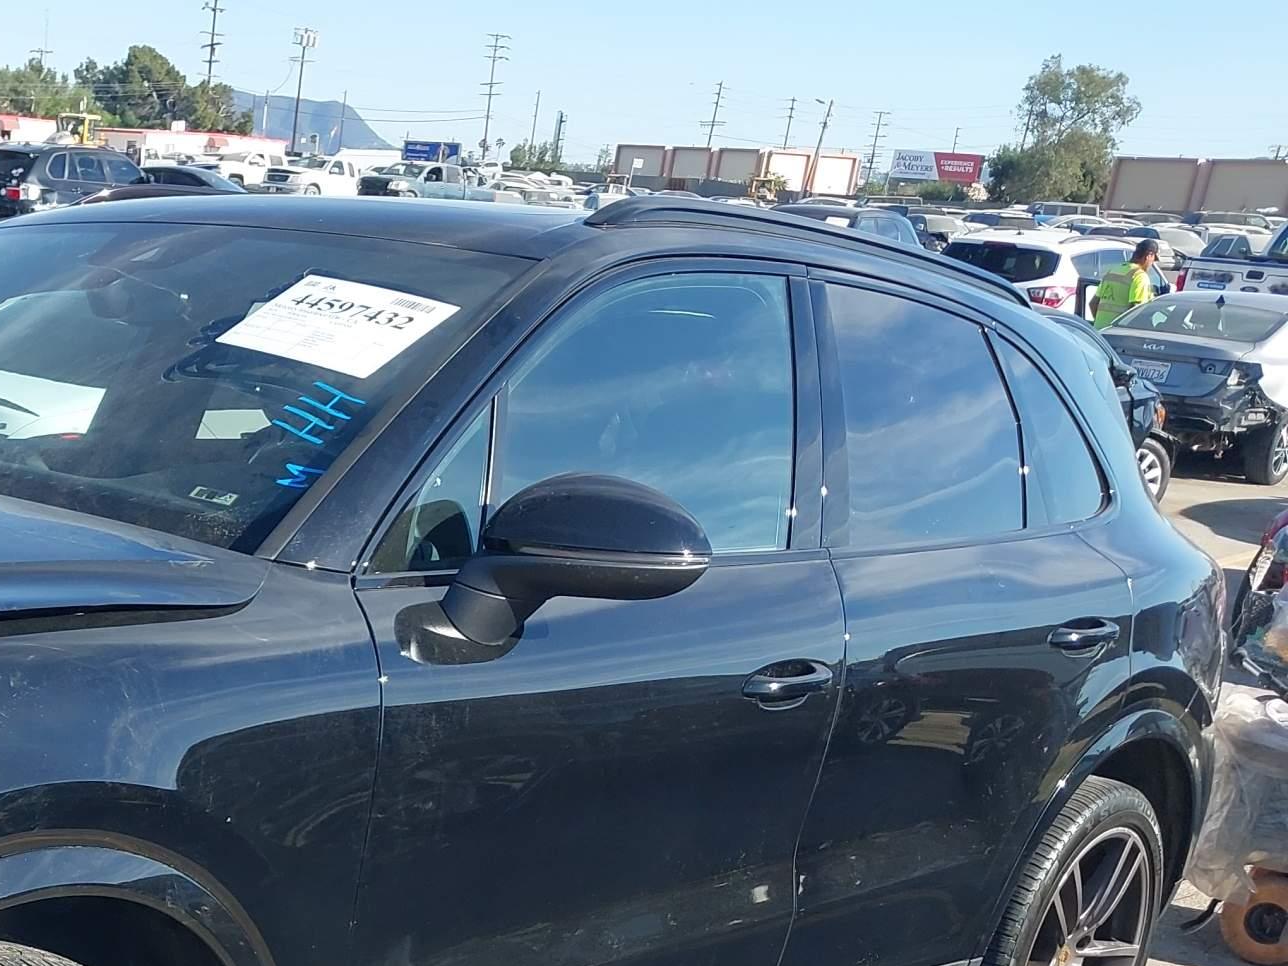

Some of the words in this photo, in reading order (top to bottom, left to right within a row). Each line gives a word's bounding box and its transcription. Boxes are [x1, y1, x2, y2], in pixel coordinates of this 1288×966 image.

[896, 152, 924, 162] JACOBY
[903, 161, 933, 172] MEYERS
[291, 293, 414, 331] 44597432
